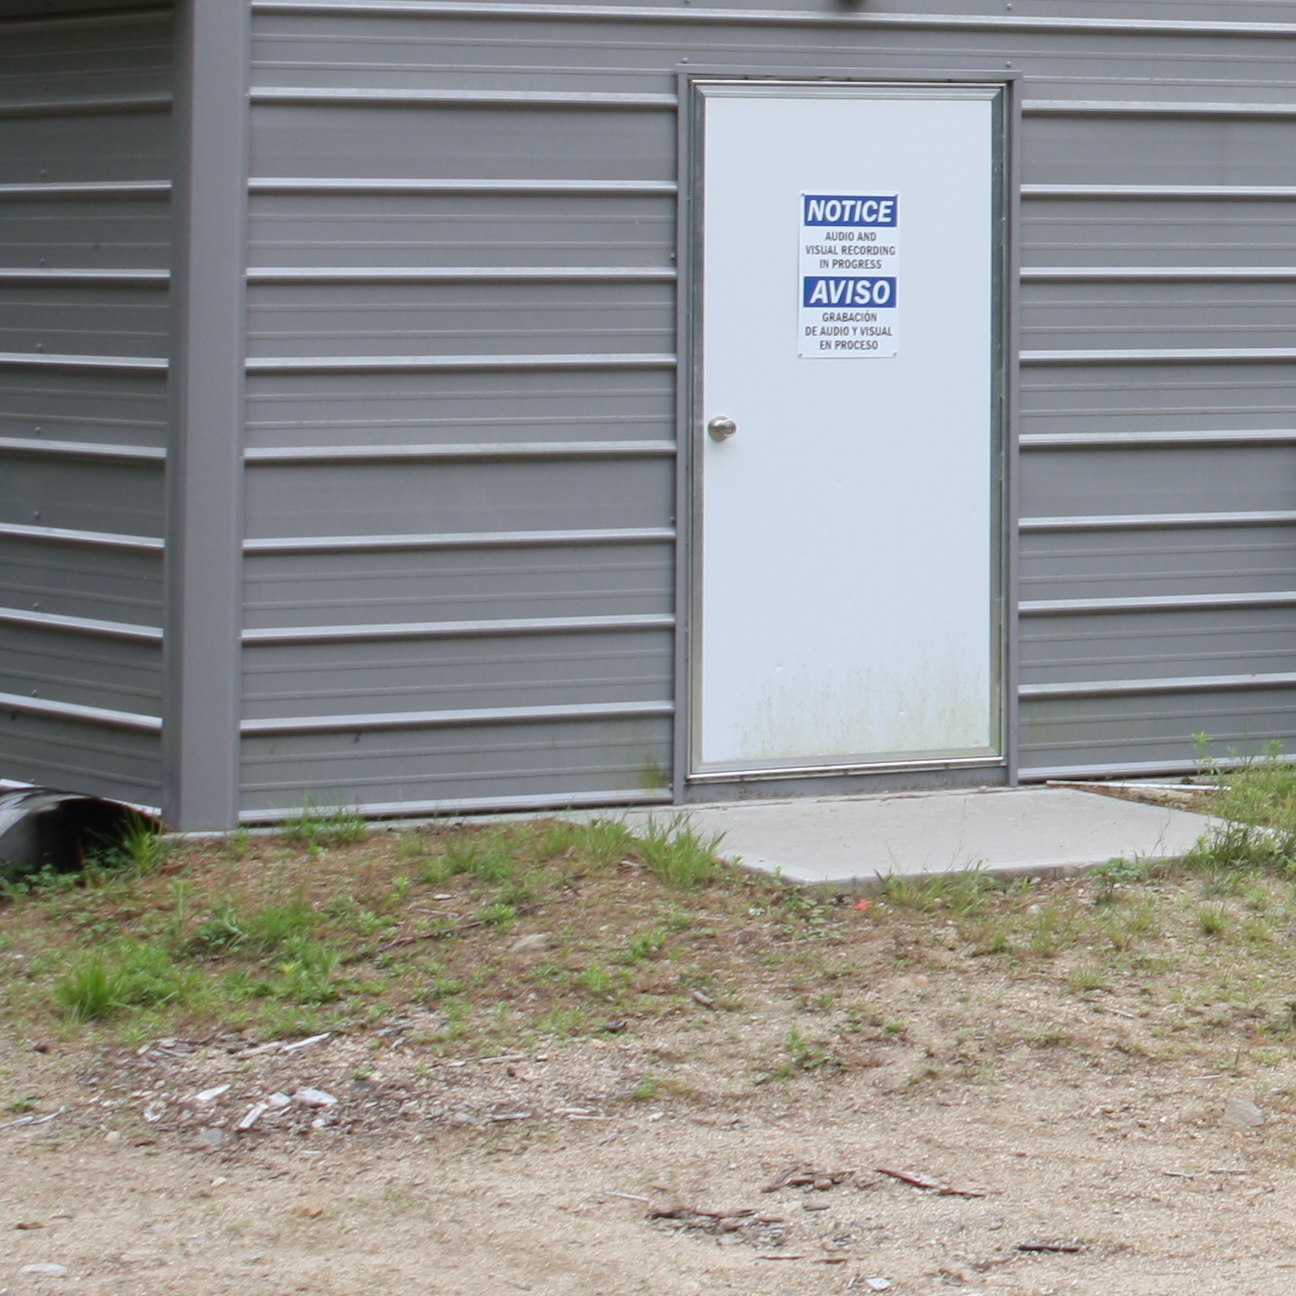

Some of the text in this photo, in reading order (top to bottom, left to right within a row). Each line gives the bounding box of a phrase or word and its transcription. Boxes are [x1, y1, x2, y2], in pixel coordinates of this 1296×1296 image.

[807, 199, 894, 222] NOTICE
[825, 231, 877, 241] AUDIO AND
[805, 245, 896, 256] VISUAL RECORDING
[819, 259, 882, 269] IN PROGRESS
[809, 280, 891, 304] AVISO
[822, 310, 877, 322] GRABACIÓN
[805, 326, 893, 336] DE AUDIO Y VISUAL
[819, 341, 879, 351] EN PROCESO
